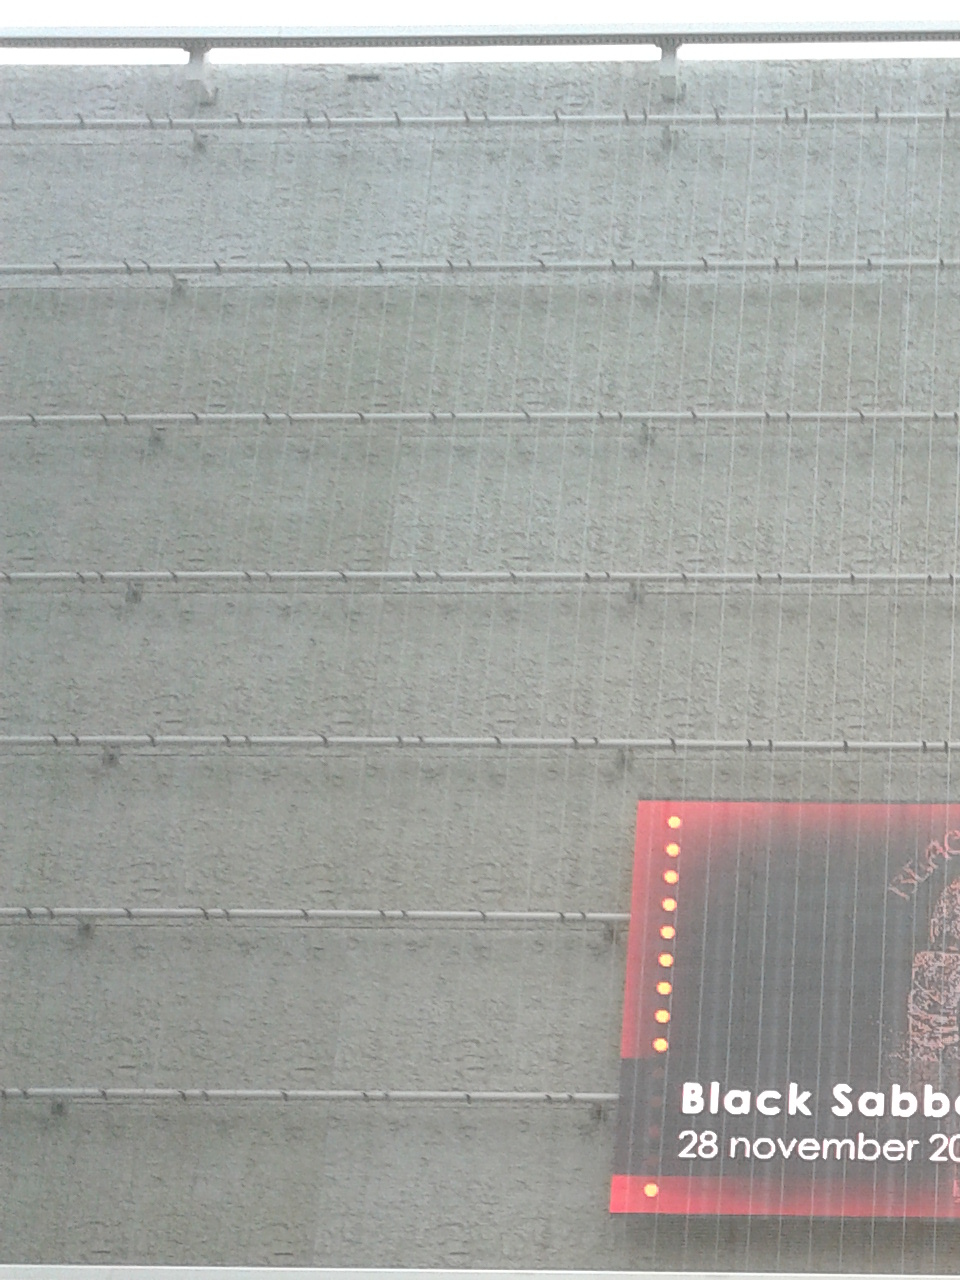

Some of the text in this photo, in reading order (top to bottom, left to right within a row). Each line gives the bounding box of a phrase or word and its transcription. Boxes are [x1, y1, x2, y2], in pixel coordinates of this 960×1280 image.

[681, 1080, 813, 1116] Black
[677, 1129, 720, 1160] 28
[729, 1131, 921, 1162] november
